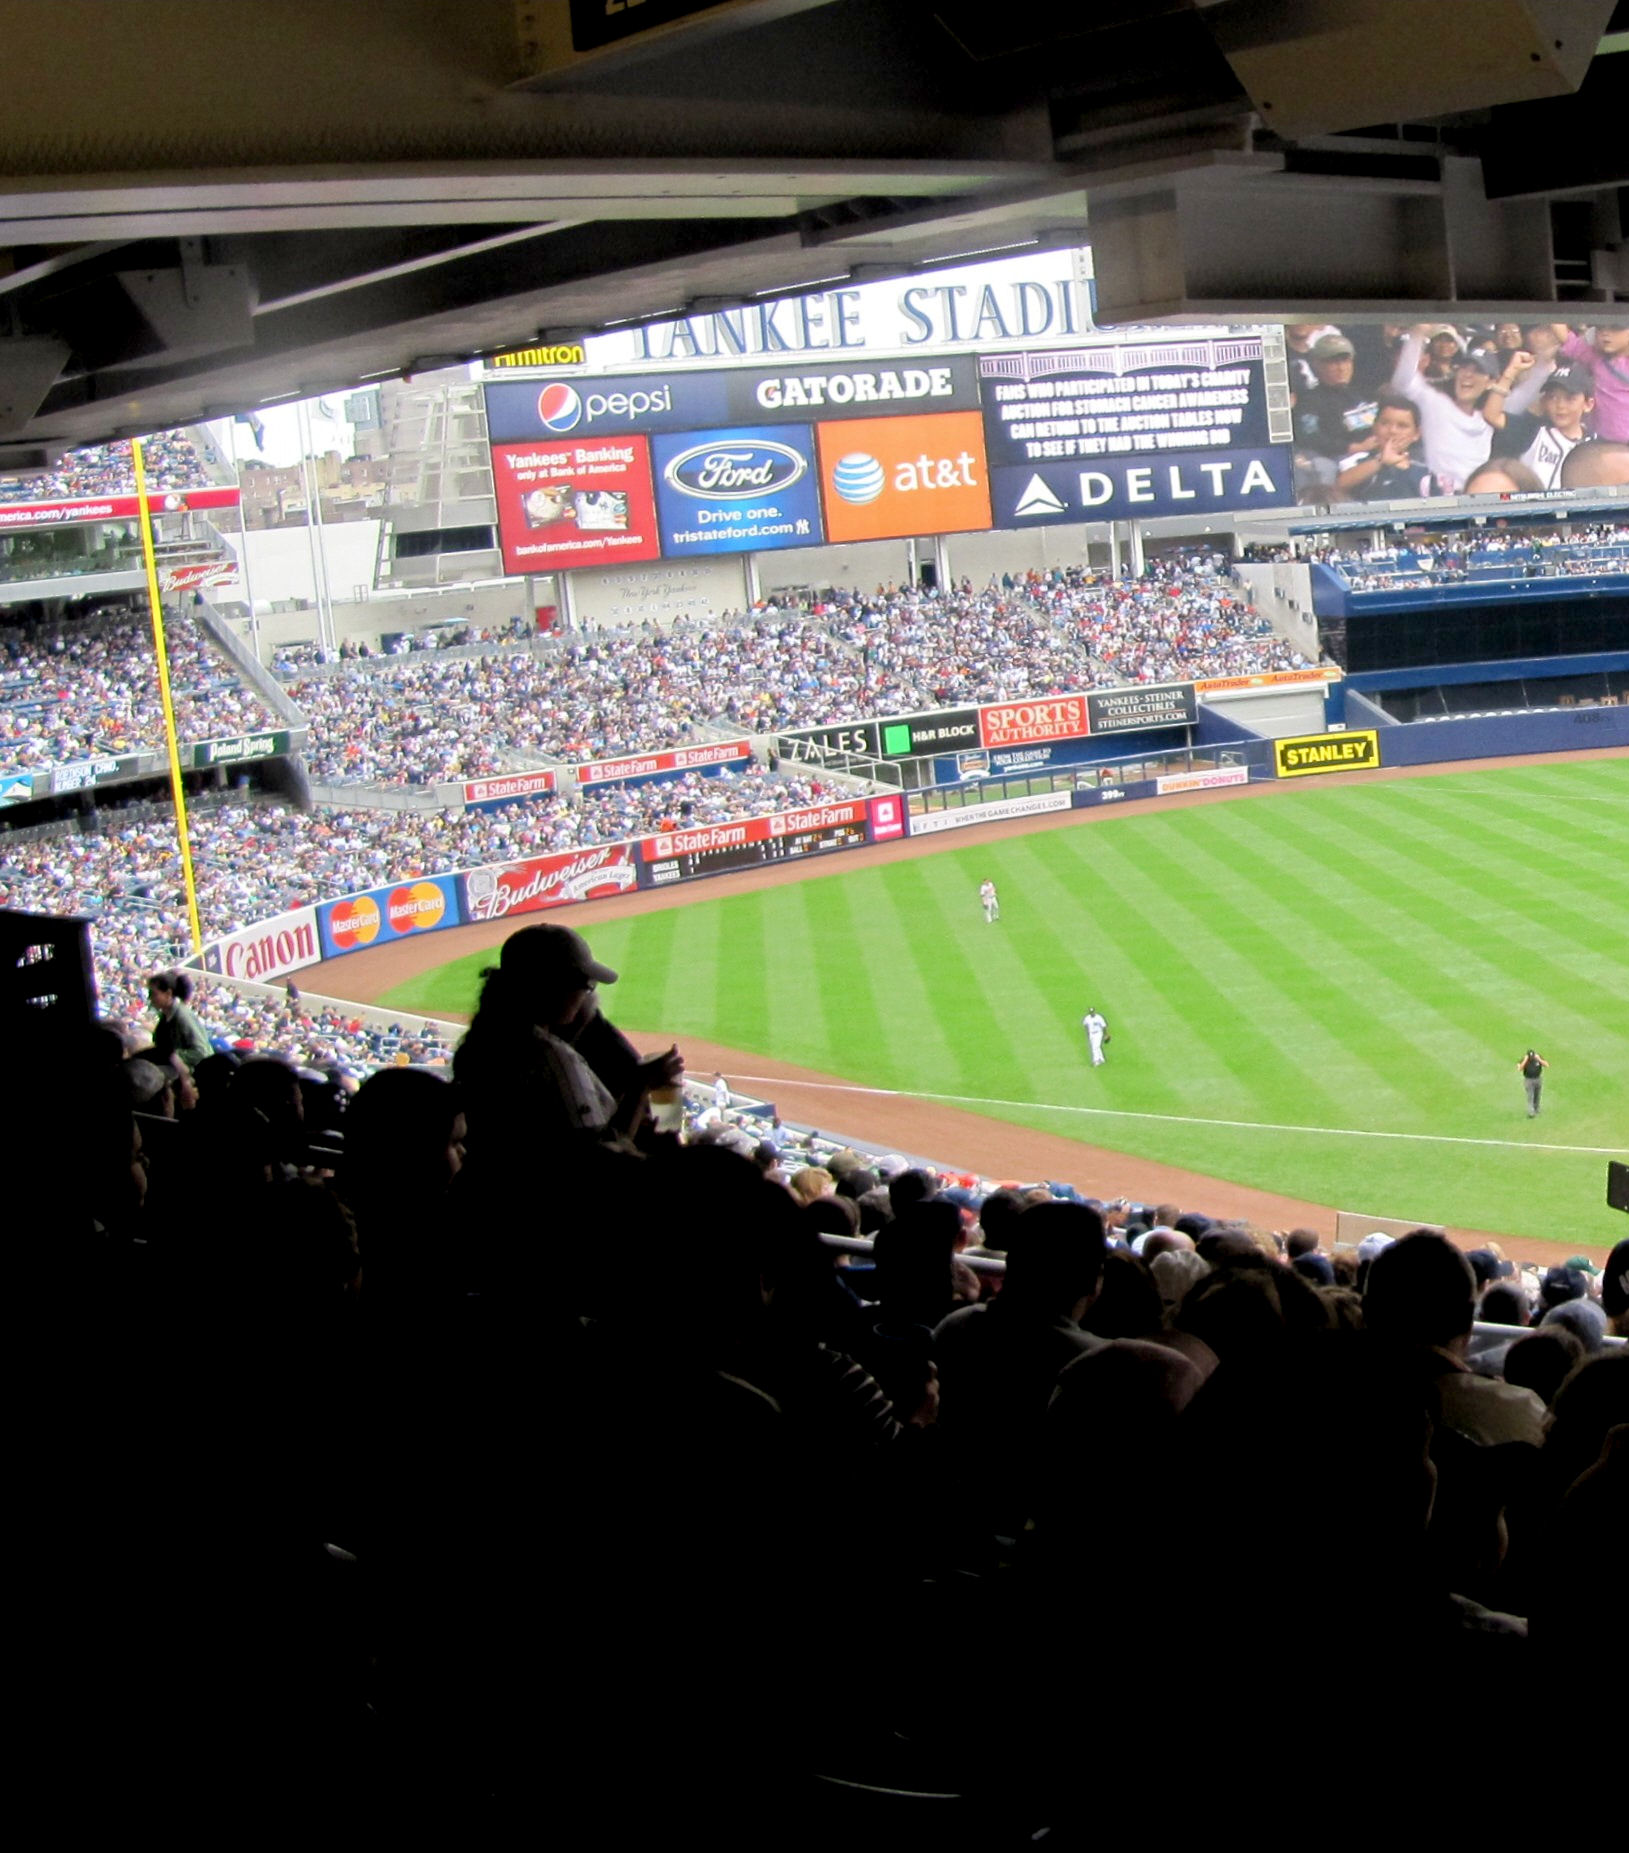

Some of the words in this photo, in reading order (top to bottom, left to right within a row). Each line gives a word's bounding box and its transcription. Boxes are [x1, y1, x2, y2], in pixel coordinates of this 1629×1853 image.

[756, 368, 953, 409] GATORADE
[1055, 377, 1136, 398] PARTICIPATED
[586, 385, 672, 422] pepsi
[1081, 418, 1096, 434] TO
[1098, 417, 1119, 432] THE
[575, 446, 634, 467] Banking
[1026, 442, 1041, 458] TO
[1042, 440, 1064, 457] SEE
[1078, 437, 1106, 453] THEY
[1133, 433, 1156, 450] THE
[517, 469, 537, 482] only
[538, 468, 549, 478] at
[550, 465, 574, 477] Bank
[576, 464, 586, 475] of
[587, 461, 627, 474] America
[699, 452, 773, 488] Ford
[894, 452, 977, 491] at&t
[1080, 460, 1276, 507] DELTA
[698, 507, 742, 523] Drive
[746, 507, 783, 521] one.
[515, 533, 643, 556] bankofamerica.com/Yankees
[673, 521, 794, 544] tristateford.com
[986, 699, 1081, 733] SPORTS
[1098, 711, 1188, 729] STEINERSPORTS.COM
[1108, 700, 1176, 717] COLLECTIBLES
[911, 730, 937, 743] H&R
[938, 724, 976, 738] BLOCK
[988, 719, 1081, 743] AUTHORITY
[788, 729, 868, 762] ZALES
[1285, 738, 1368, 767] STANLEY
[478, 846, 612, 919] Budweiser
[390, 897, 444, 921] MasterCard
[332, 914, 380, 934] MasterCard
[226, 921, 316, 980] Canon
